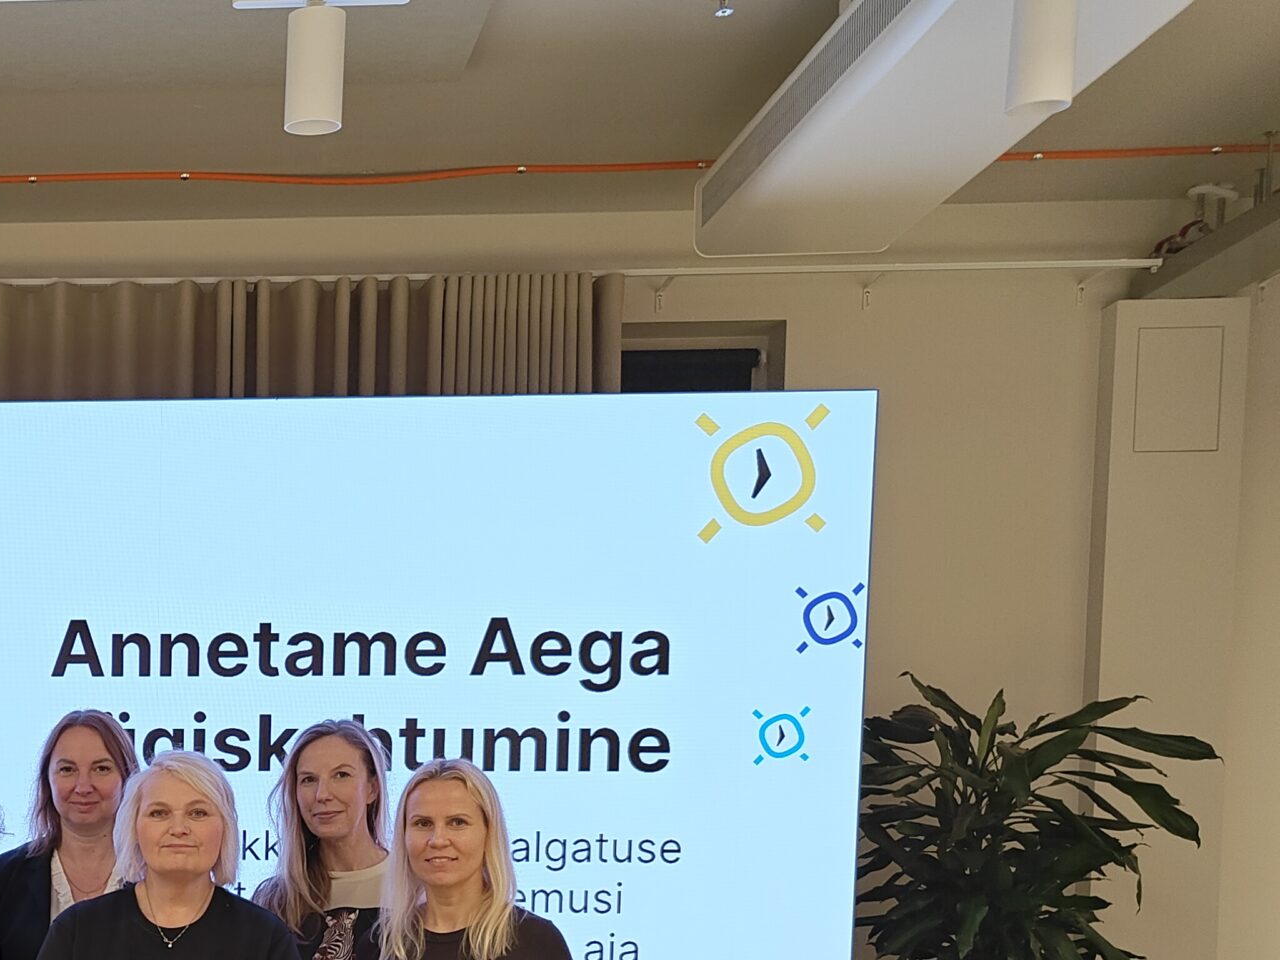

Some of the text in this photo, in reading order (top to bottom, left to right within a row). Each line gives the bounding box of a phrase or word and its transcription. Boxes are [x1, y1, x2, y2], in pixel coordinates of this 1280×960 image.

[51, 617, 671, 693] Annetame Aega
[511, 830, 682, 872] algatuse
